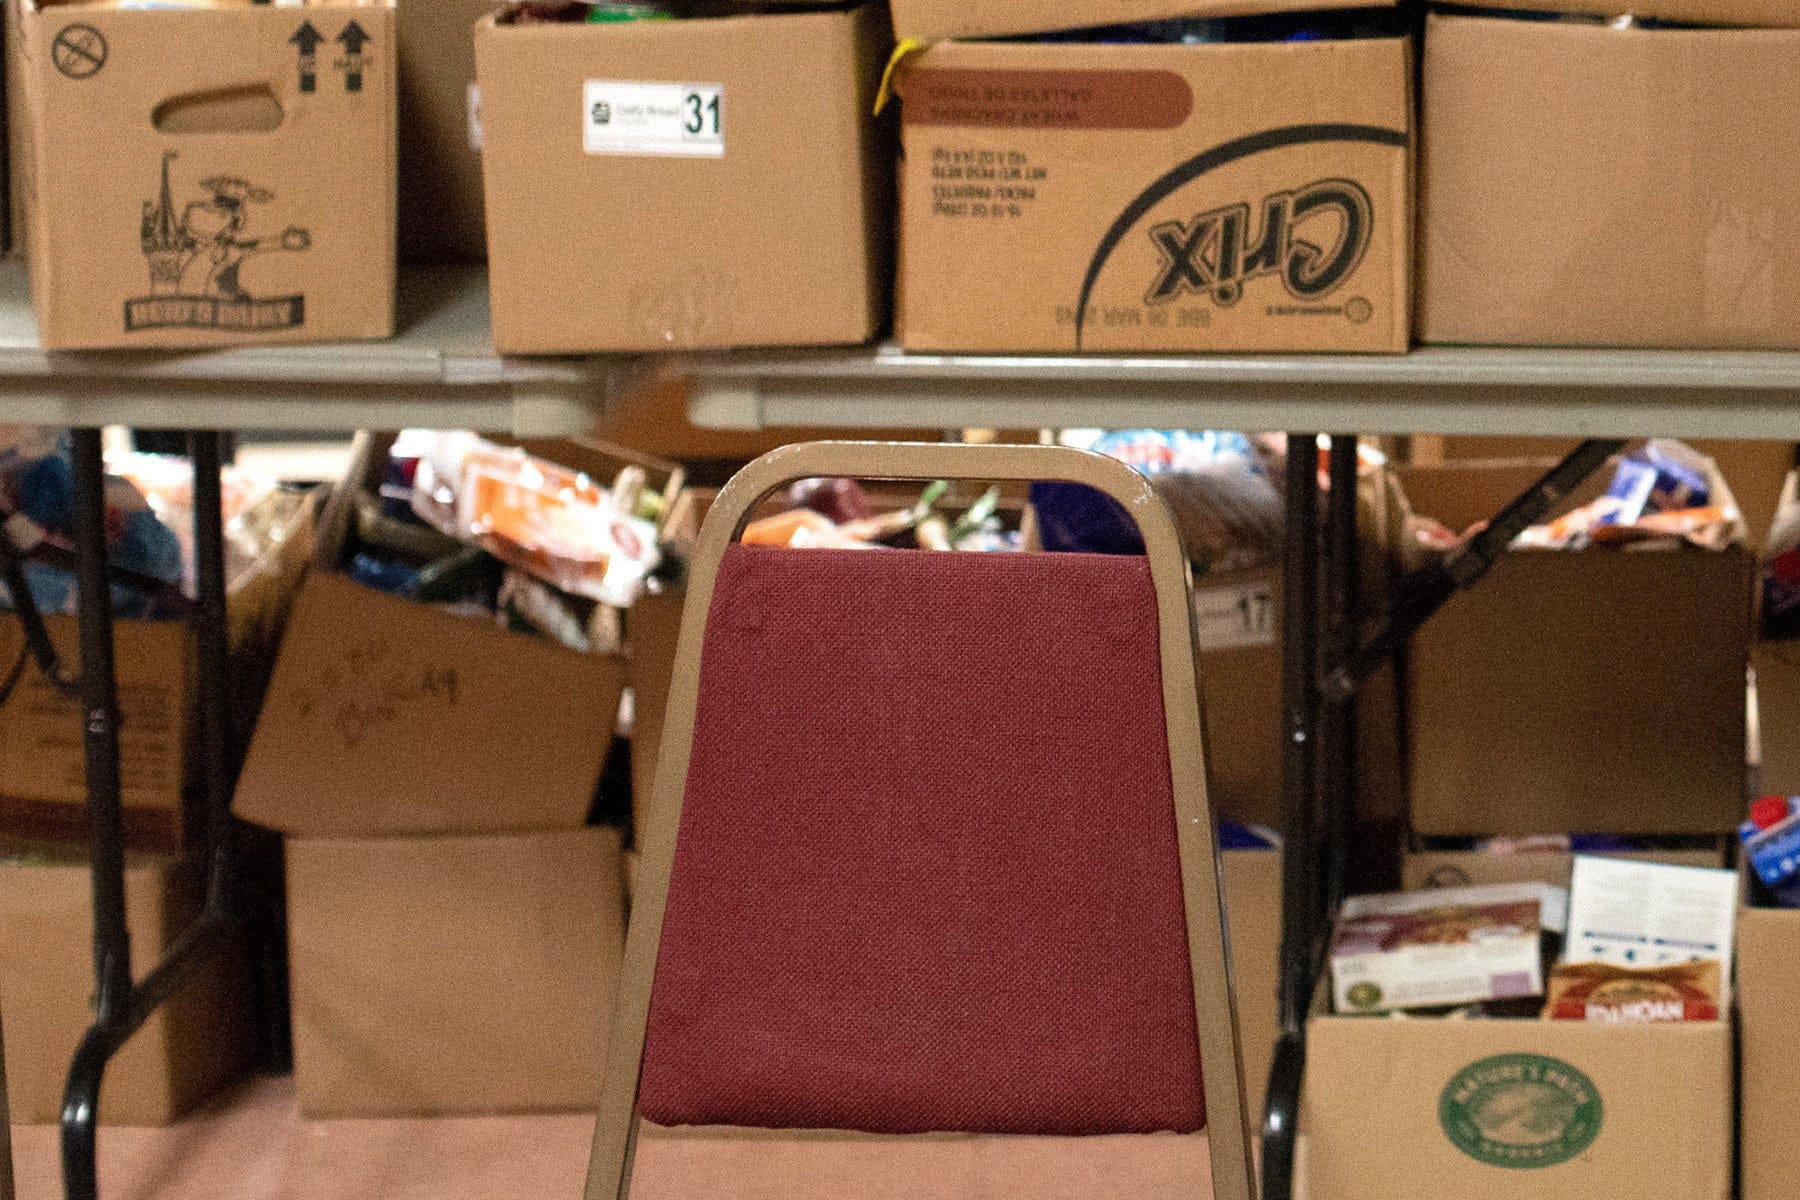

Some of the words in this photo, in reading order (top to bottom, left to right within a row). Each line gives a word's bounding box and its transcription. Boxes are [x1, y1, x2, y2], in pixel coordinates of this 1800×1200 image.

[684, 91, 722, 135] 31
[931, 165, 963, 179] NETO
[965, 166, 996, 180] PESO
[1144, 177, 1375, 308] Crix
